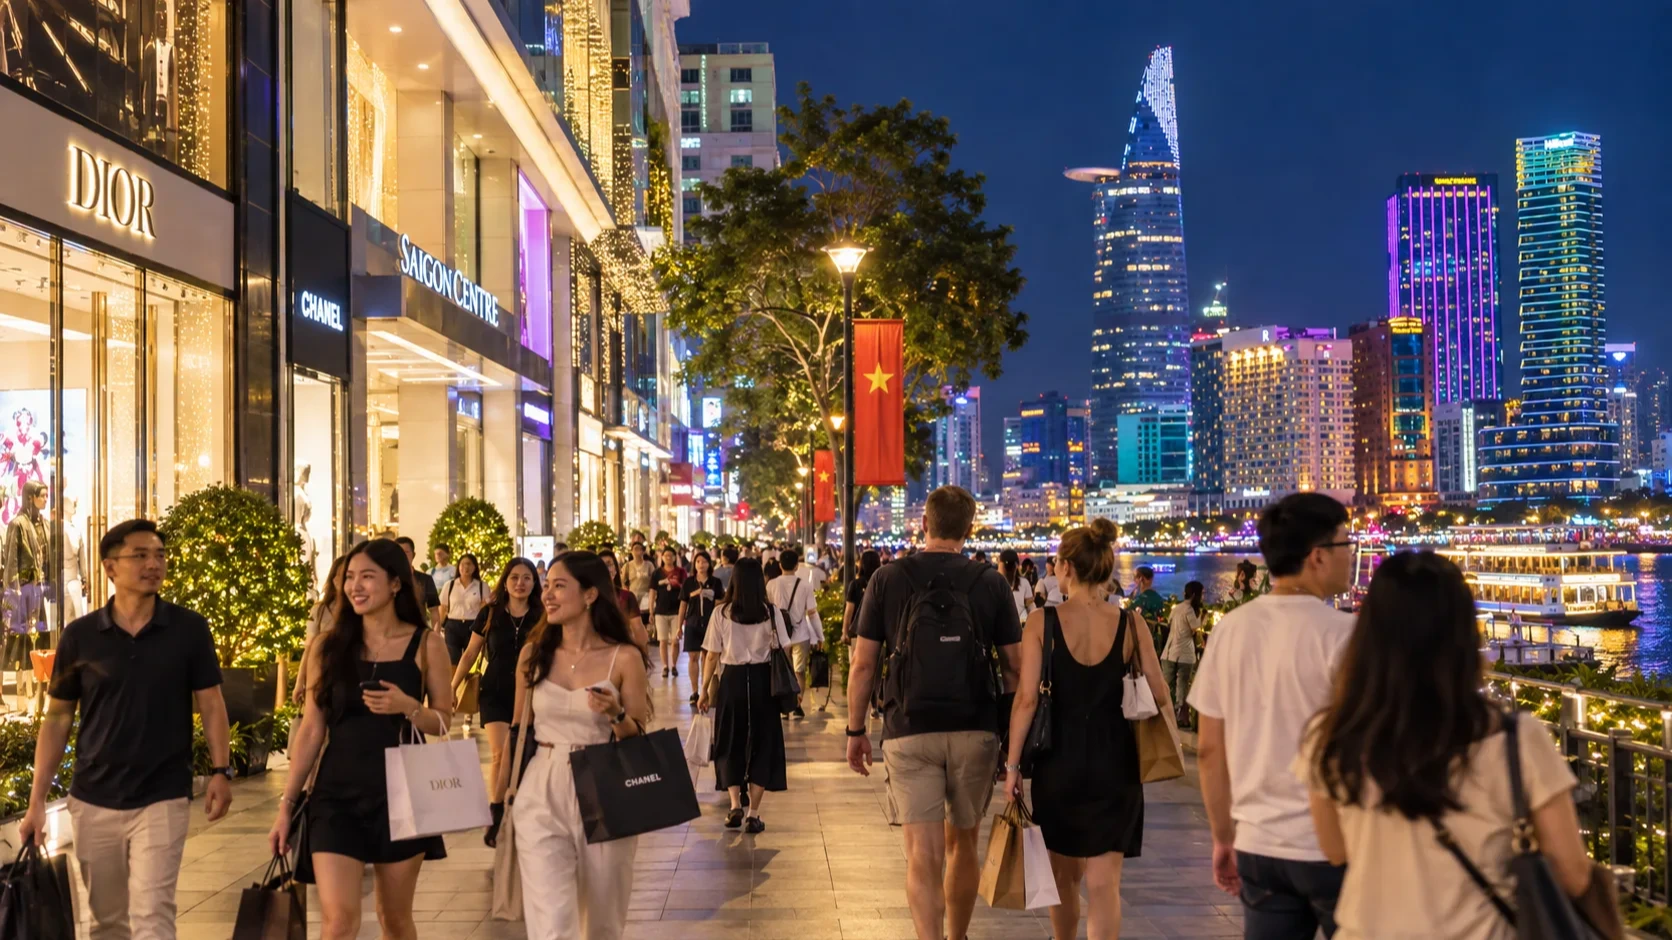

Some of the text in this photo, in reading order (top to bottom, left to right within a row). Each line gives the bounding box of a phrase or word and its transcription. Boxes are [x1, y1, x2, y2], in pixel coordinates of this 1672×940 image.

[69, 145, 156, 239] DIOR
[401, 233, 499, 327] SAIGON CENTRE
[301, 290, 343, 331] CHANEL
[430, 777, 462, 790] DIOR
[625, 773, 662, 787] CHANEL
